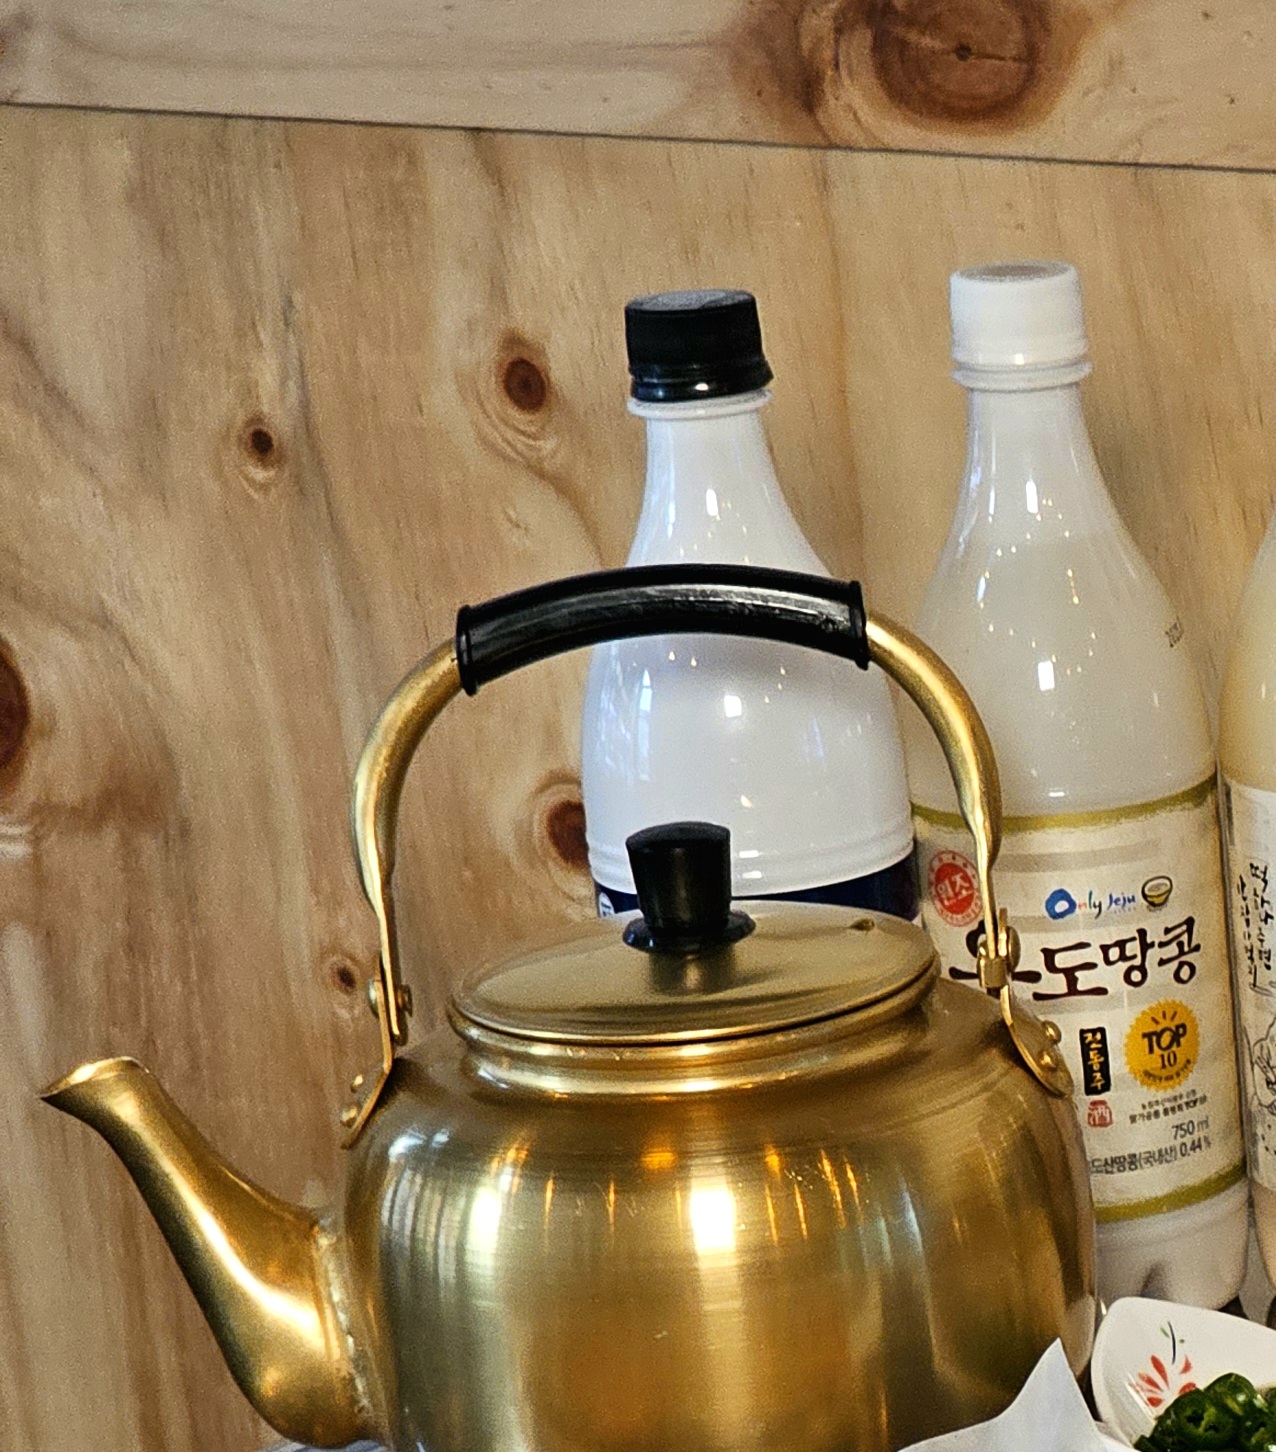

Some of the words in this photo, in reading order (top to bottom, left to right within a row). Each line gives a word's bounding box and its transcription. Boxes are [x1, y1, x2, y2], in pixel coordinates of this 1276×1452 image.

[1108, 891, 1136, 911] Jeju
[1141, 1022, 1188, 1055] TOP
[1082, 1031, 1106, 1091] 전통주
[1158, 1050, 1178, 1070] 10
[1171, 1120, 1195, 1141] 750
[1091, 1144, 1178, 1175] 도산땅콩(국내산)
